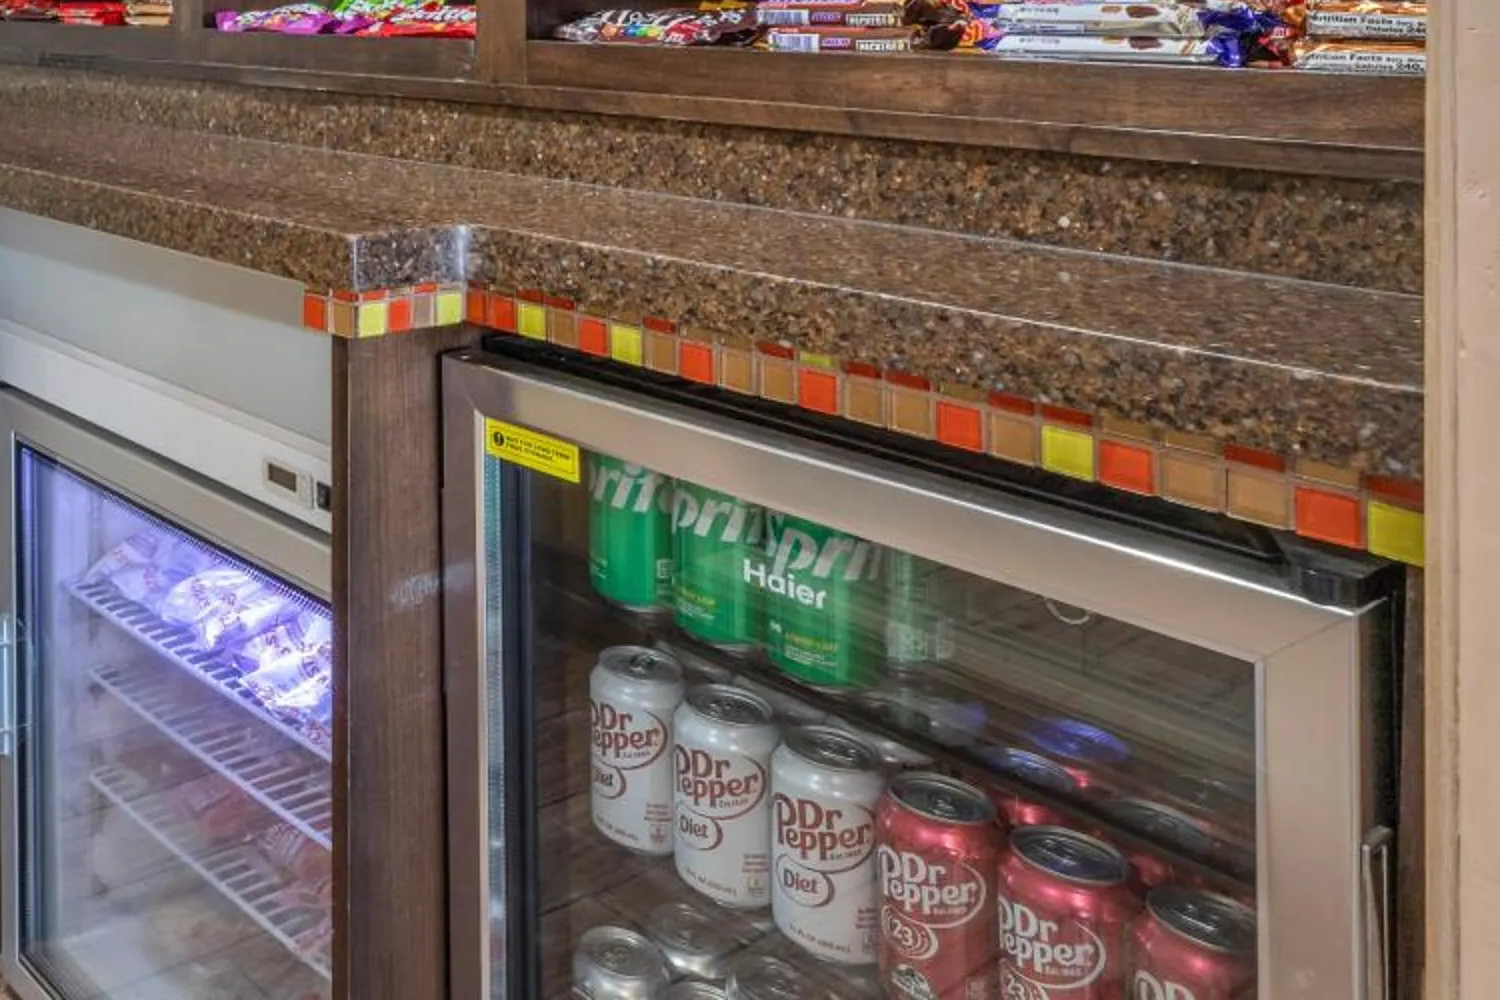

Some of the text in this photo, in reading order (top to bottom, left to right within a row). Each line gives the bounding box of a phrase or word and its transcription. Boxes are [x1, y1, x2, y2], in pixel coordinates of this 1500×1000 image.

[743, 557, 827, 609] Haier
[600, 703, 633, 731] Dr
[691, 750, 731, 779] Dr
[679, 815, 709, 839] Diet
[775, 792, 872, 861] Pepper
[800, 801, 843, 830] Dr
[783, 868, 819, 895] Diet
[878, 844, 979, 916] Pepper
[902, 852, 947, 886] Dr
[890, 918, 915, 947] 23
[1013, 903, 1059, 942] Dr
